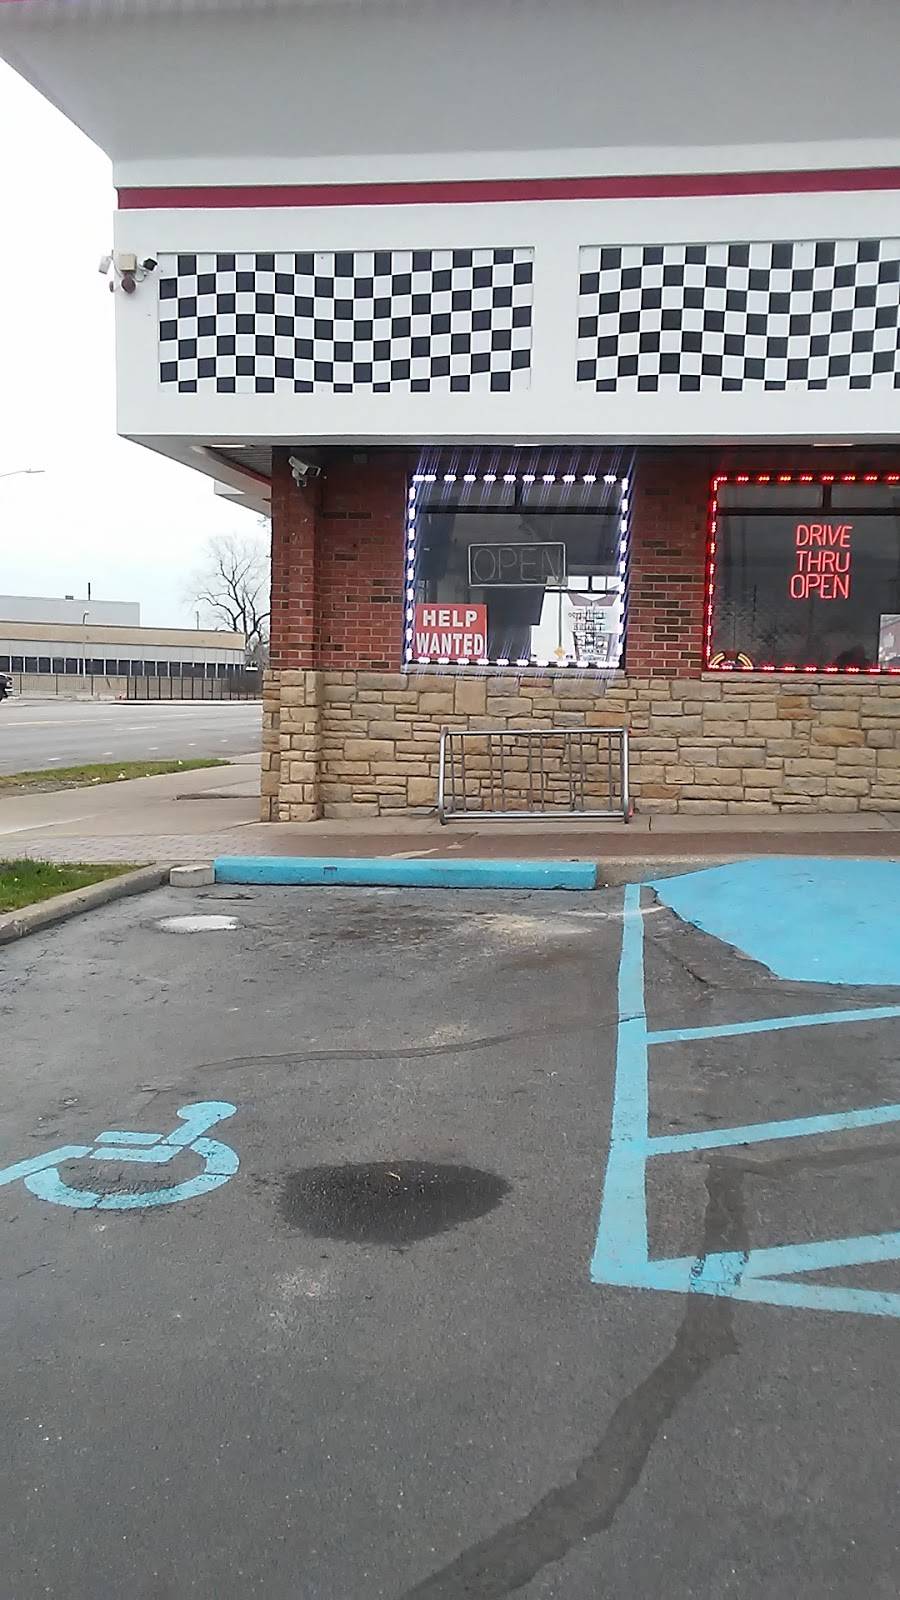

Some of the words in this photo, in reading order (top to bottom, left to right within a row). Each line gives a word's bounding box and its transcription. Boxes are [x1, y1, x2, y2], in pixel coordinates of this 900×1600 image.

[796, 524, 853, 548] DRIVE
[473, 548, 561, 582] OPEN
[796, 550, 850, 573] THRU
[790, 574, 850, 599] OPEN
[422, 609, 478, 627] HELP
[416, 632, 484, 657] WANTED
